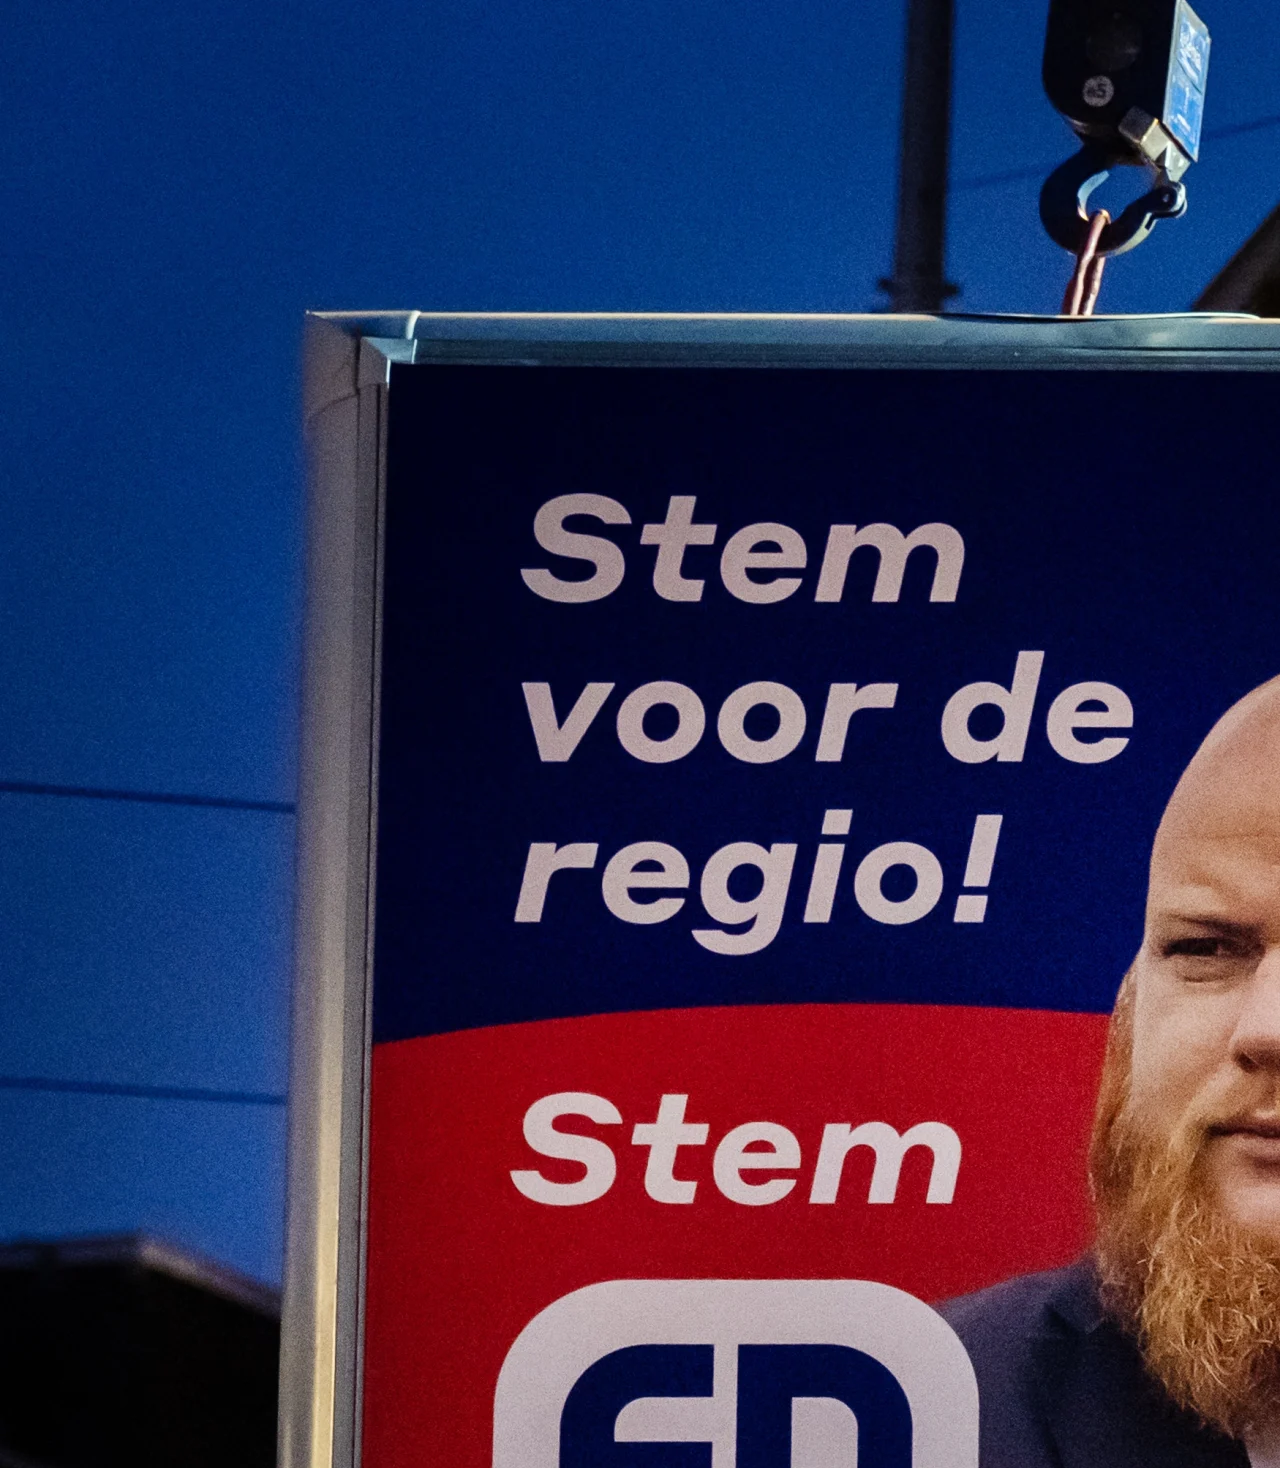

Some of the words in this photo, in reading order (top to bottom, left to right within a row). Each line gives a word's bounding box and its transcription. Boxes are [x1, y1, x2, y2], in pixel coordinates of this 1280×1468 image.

[519, 492, 966, 604] Stem
[519, 680, 899, 764] voor
[940, 650, 1135, 765] de
[513, 808, 1004, 956] regio!
[508, 1091, 962, 1206] Stem
